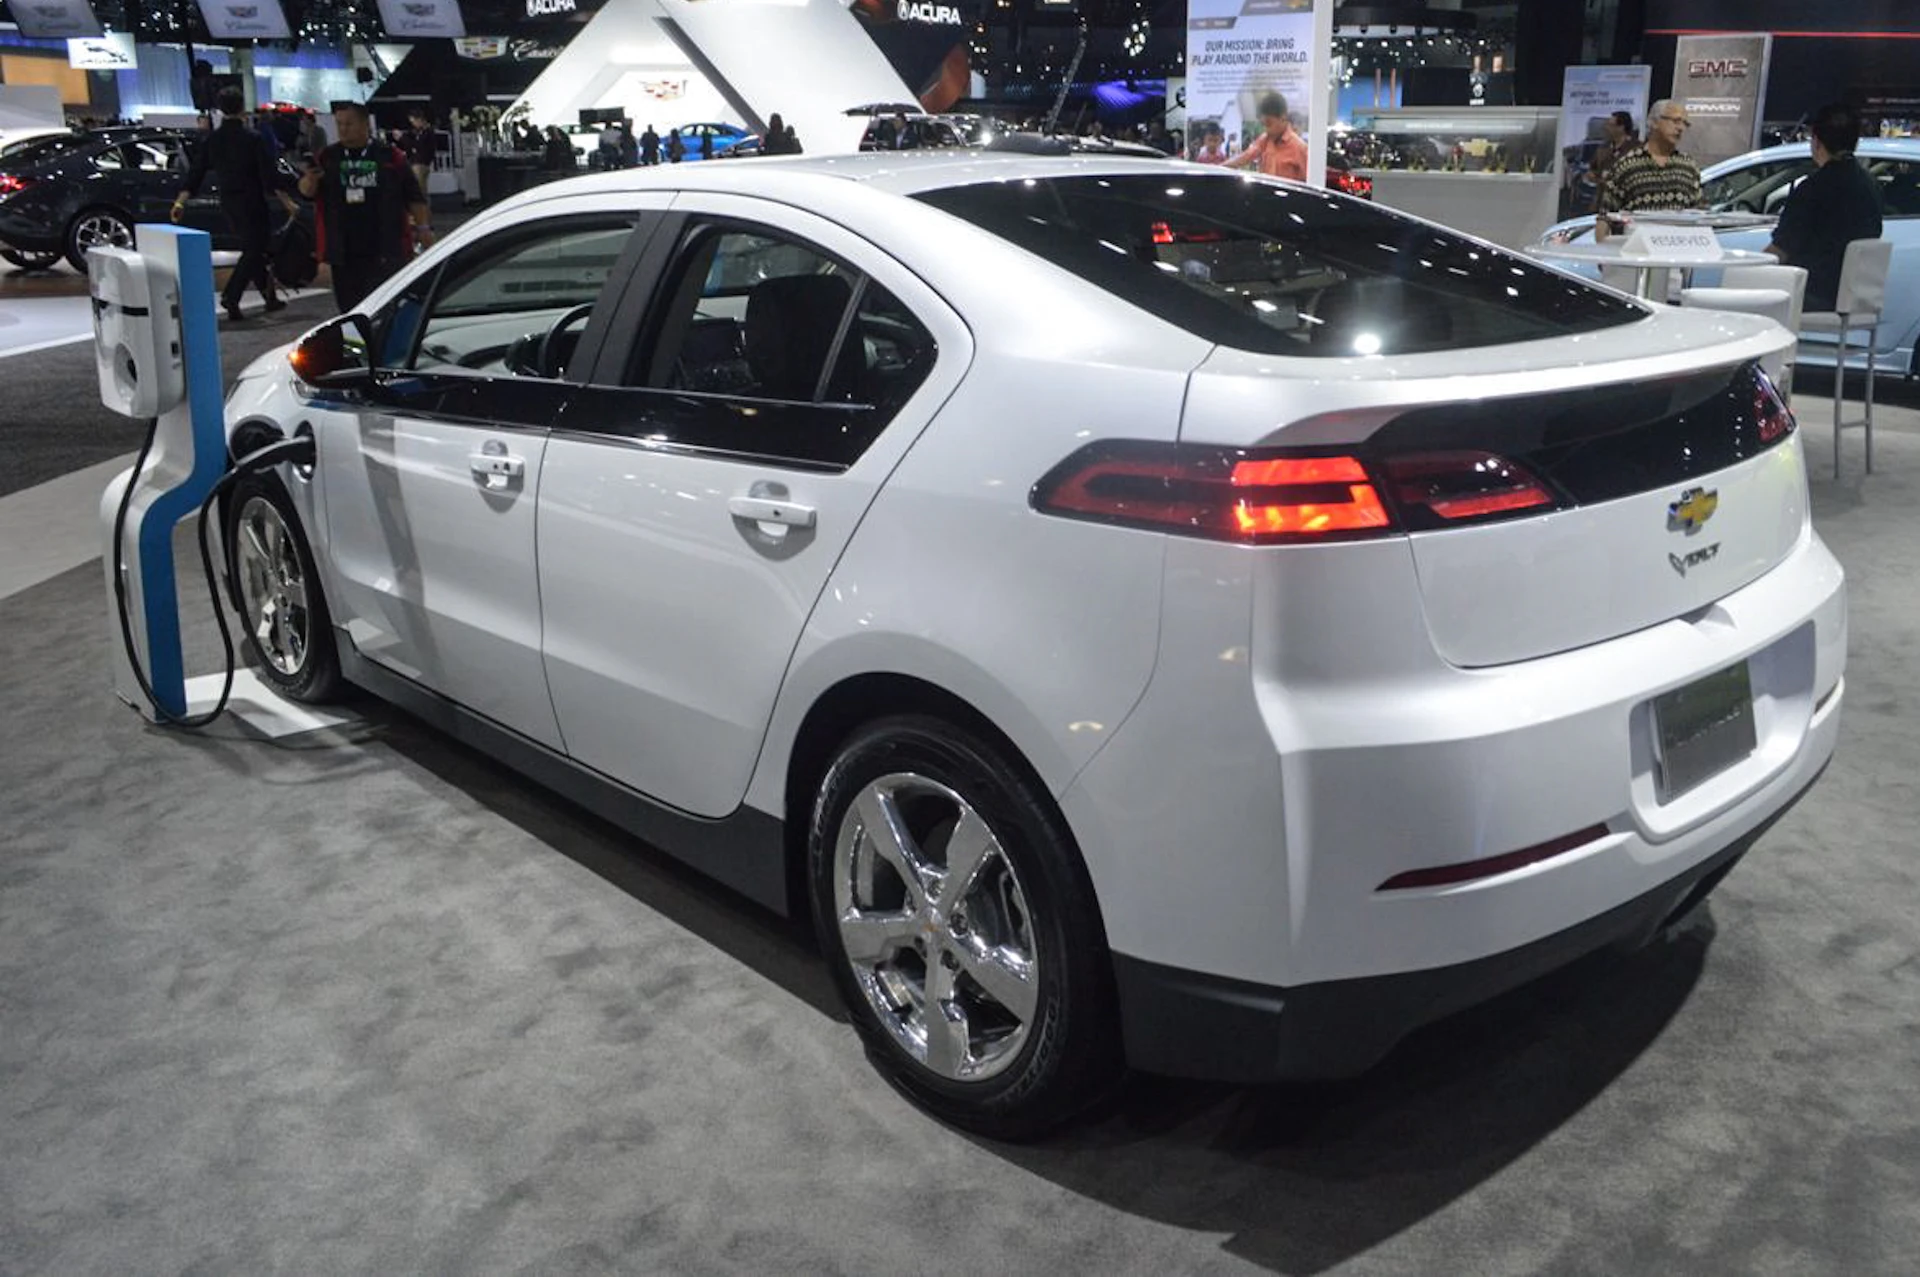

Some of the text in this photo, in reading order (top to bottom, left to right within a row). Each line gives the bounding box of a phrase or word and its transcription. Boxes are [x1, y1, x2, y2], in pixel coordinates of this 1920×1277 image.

[535, 0, 577, 14] ACURA
[908, 2, 962, 25] ACURA
[1205, 40, 1223, 52] OUR
[1266, 38, 1295, 50] BRING
[1192, 55, 1213, 66] PLAY
[1214, 53, 1252, 65] AROUND
[1253, 52, 1271, 64] THE
[1688, 59, 1748, 76] GMC
[1650, 234, 1711, 247] RESERVED
